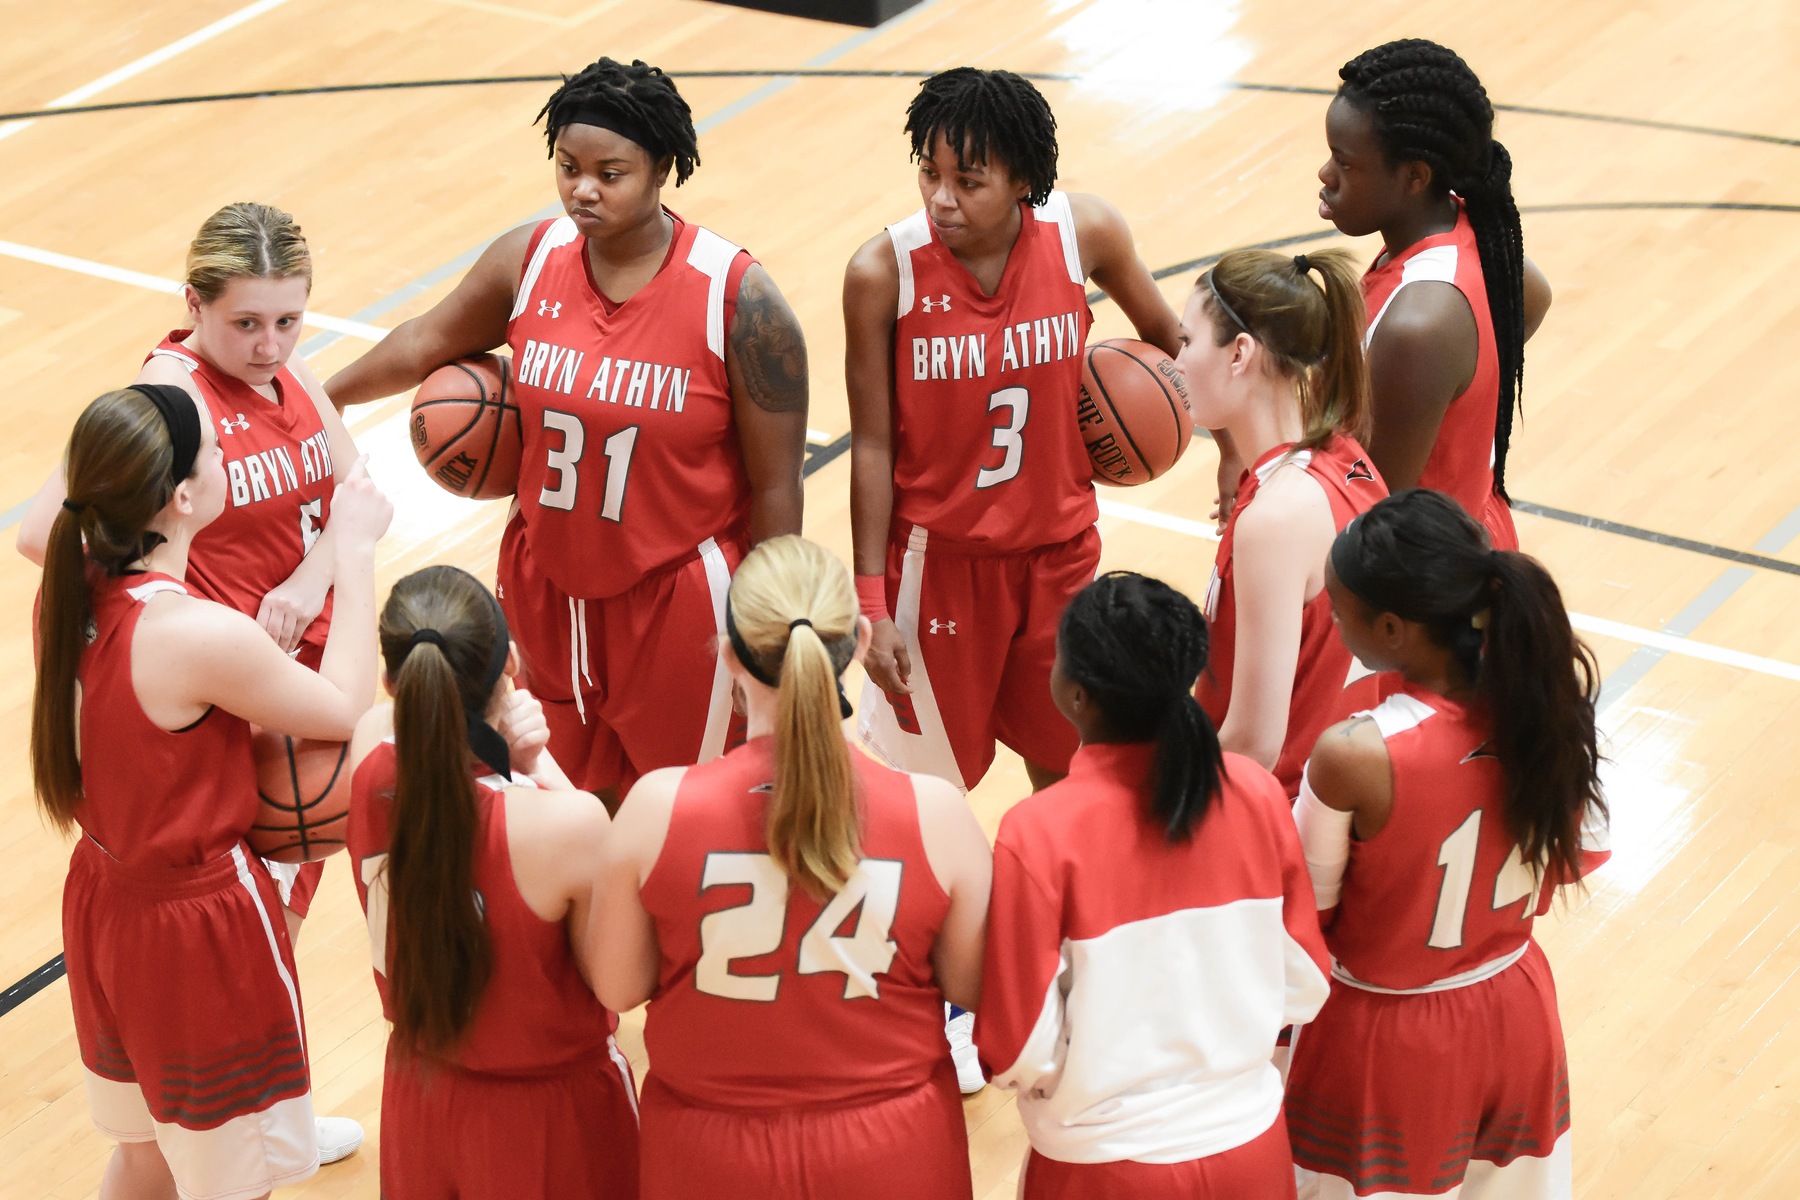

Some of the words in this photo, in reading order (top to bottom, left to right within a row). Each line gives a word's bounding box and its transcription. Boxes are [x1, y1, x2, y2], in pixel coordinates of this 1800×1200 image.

[518, 339, 585, 395] BRYN
[586, 356, 690, 413] ATHYN
[912, 333, 985, 381] BRYN
[1001, 311, 1079, 373] ATHYN
[227, 445, 299, 508] BRYN
[300, 429, 333, 486] ATH
[538, 408, 641, 523] 31
[975, 385, 1030, 490] 3
[1087, 432, 1134, 479] ROCK
[1426, 808, 1551, 949] 14
[694, 850, 905, 1004] 24
